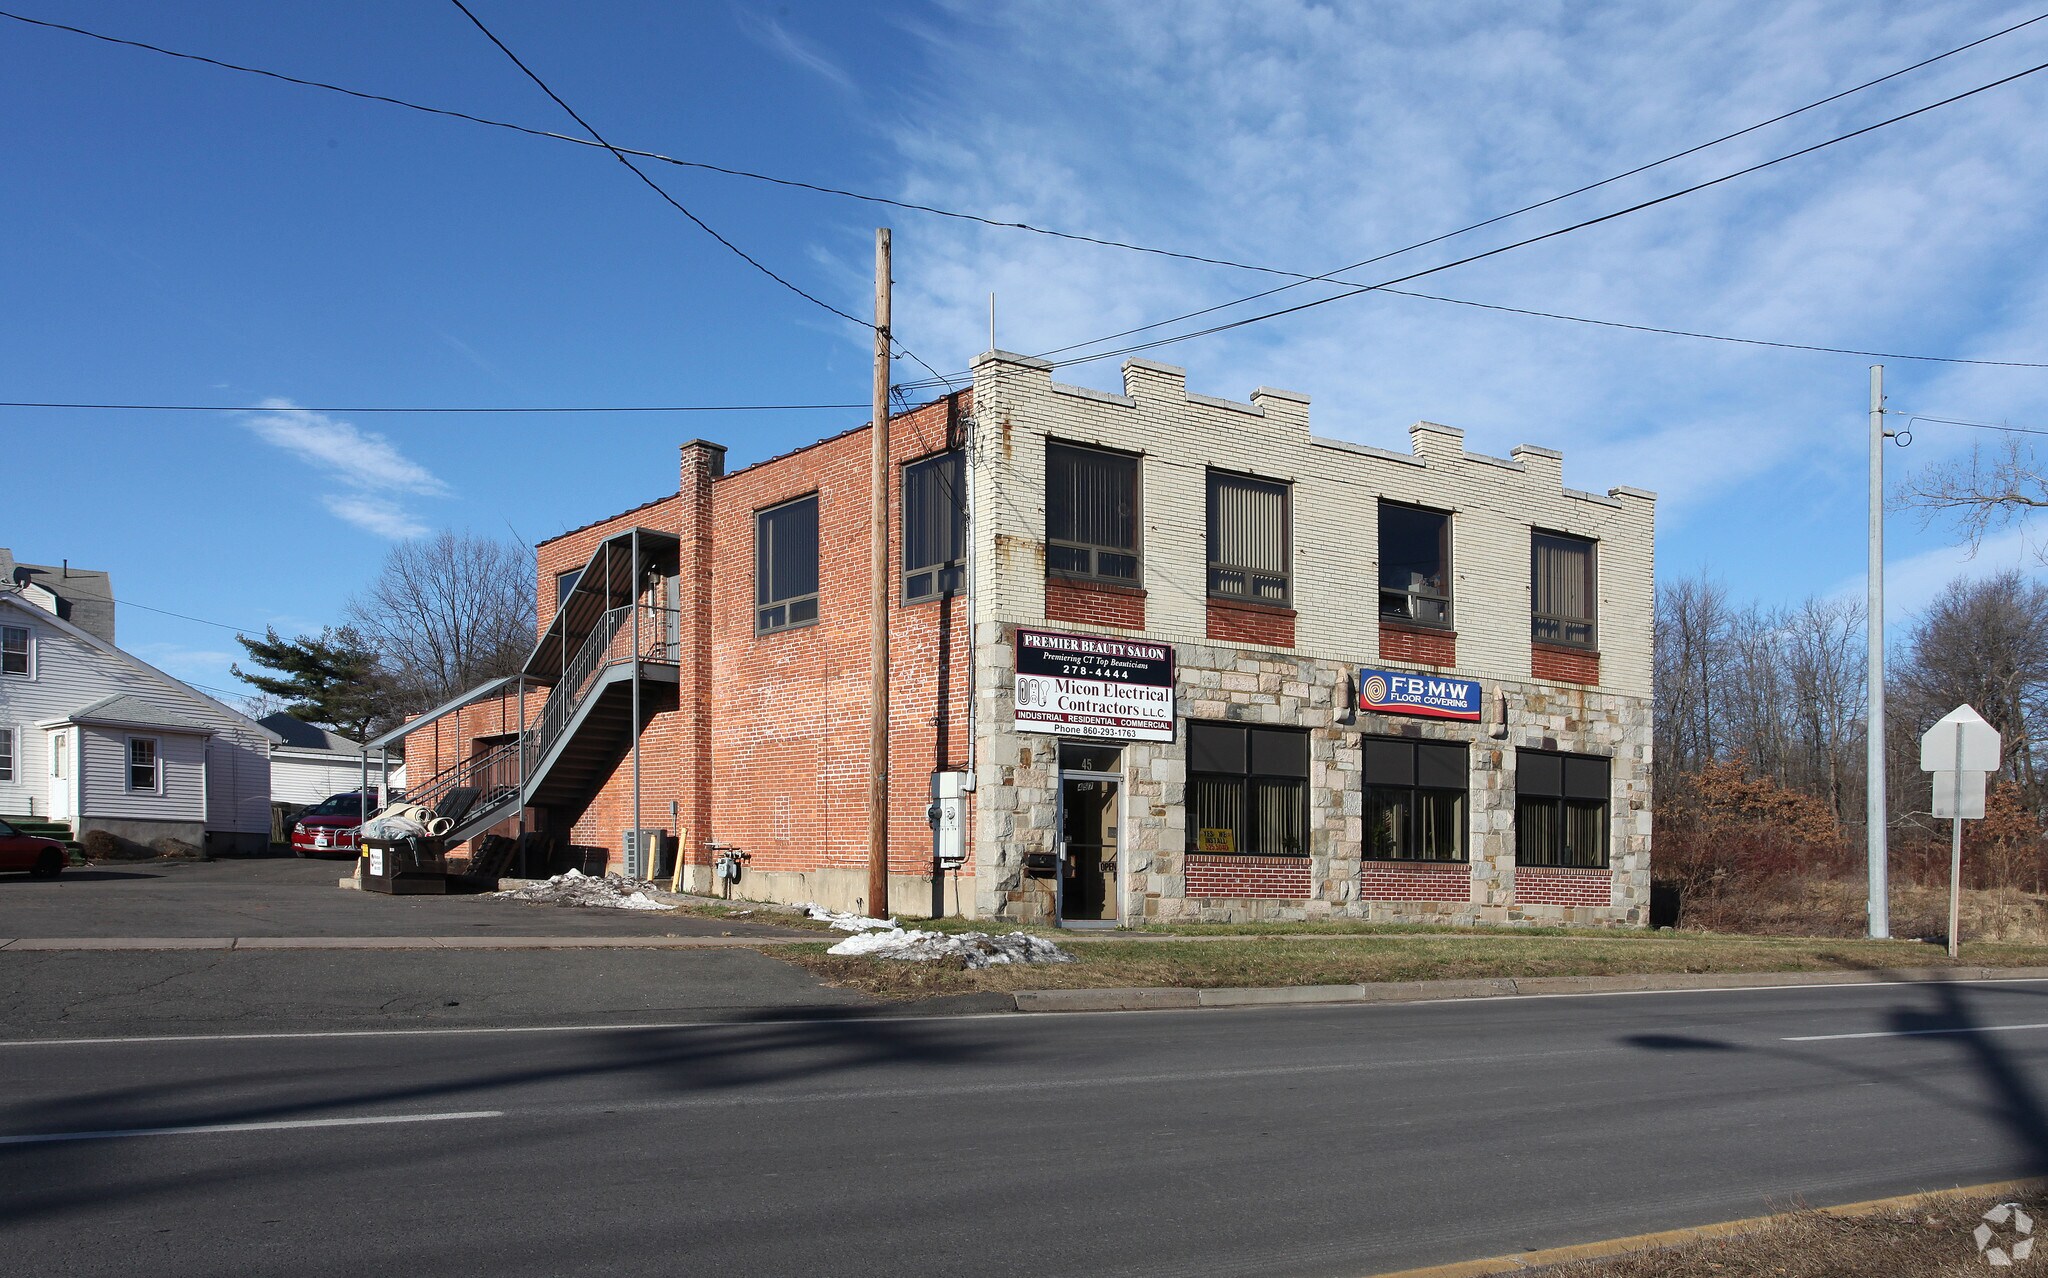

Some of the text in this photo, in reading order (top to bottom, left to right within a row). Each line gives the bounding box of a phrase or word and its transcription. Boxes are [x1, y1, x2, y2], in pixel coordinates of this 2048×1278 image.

[1024, 634, 1165, 660] PREMIER BEAUTY SALON
[1043, 651, 1149, 670] Premiering CT Top Beauticians
[1063, 664, 1129, 680] 278-4444
[1055, 678, 1169, 702] Micon Electrical
[1058, 695, 1167, 718] Contractors L.L.C.
[1390, 692, 1468, 708] FLOOR COVERING
[1018, 710, 1170, 730] INDUSTRIAL RESIDENTIAL COMMERCIAL
[1054, 724, 1137, 738] Phone 860-293-1763
[1081, 758, 1092, 770] 45
